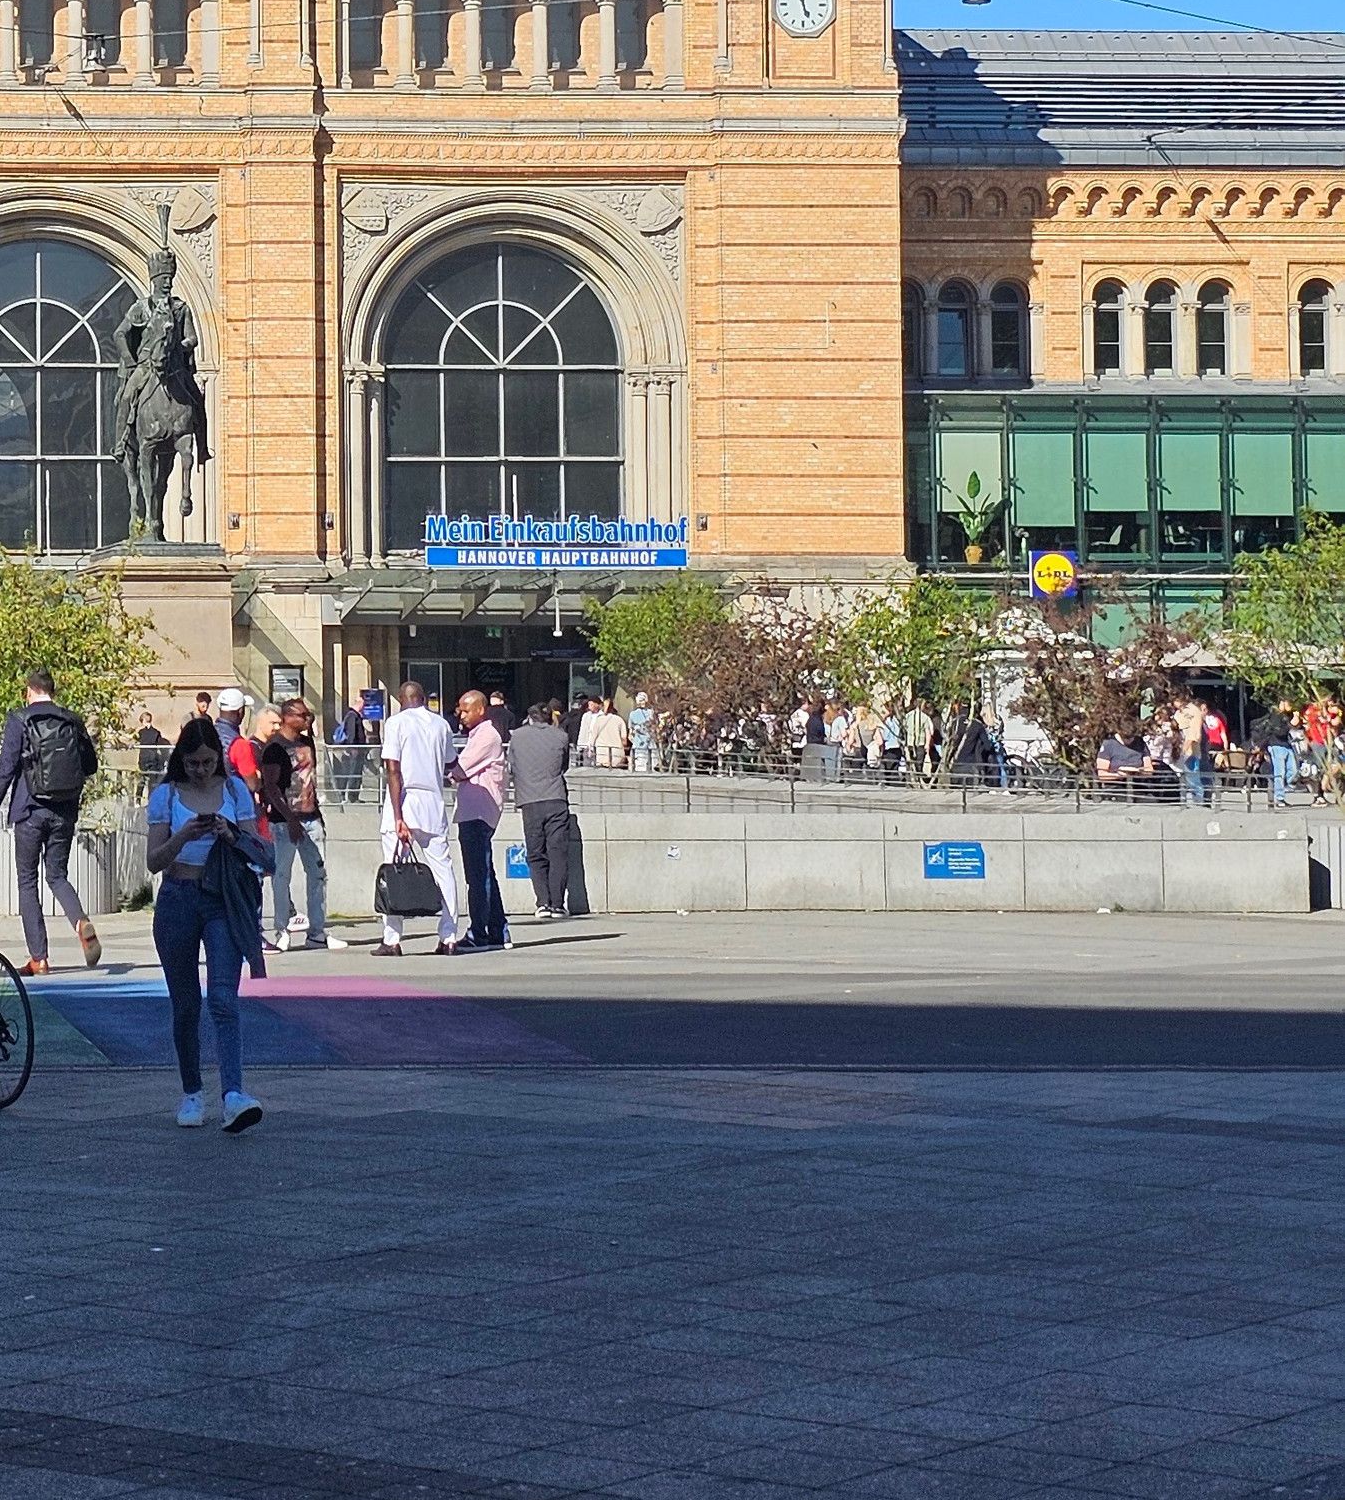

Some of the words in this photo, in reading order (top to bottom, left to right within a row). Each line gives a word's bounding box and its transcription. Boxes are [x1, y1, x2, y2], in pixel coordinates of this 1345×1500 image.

[426, 515, 486, 543] Mein
[489, 514, 688, 543] Einkaufsbahnhof
[458, 550, 535, 565] HANNOVER
[541, 550, 658, 565] HAUPTBAHNHOF
